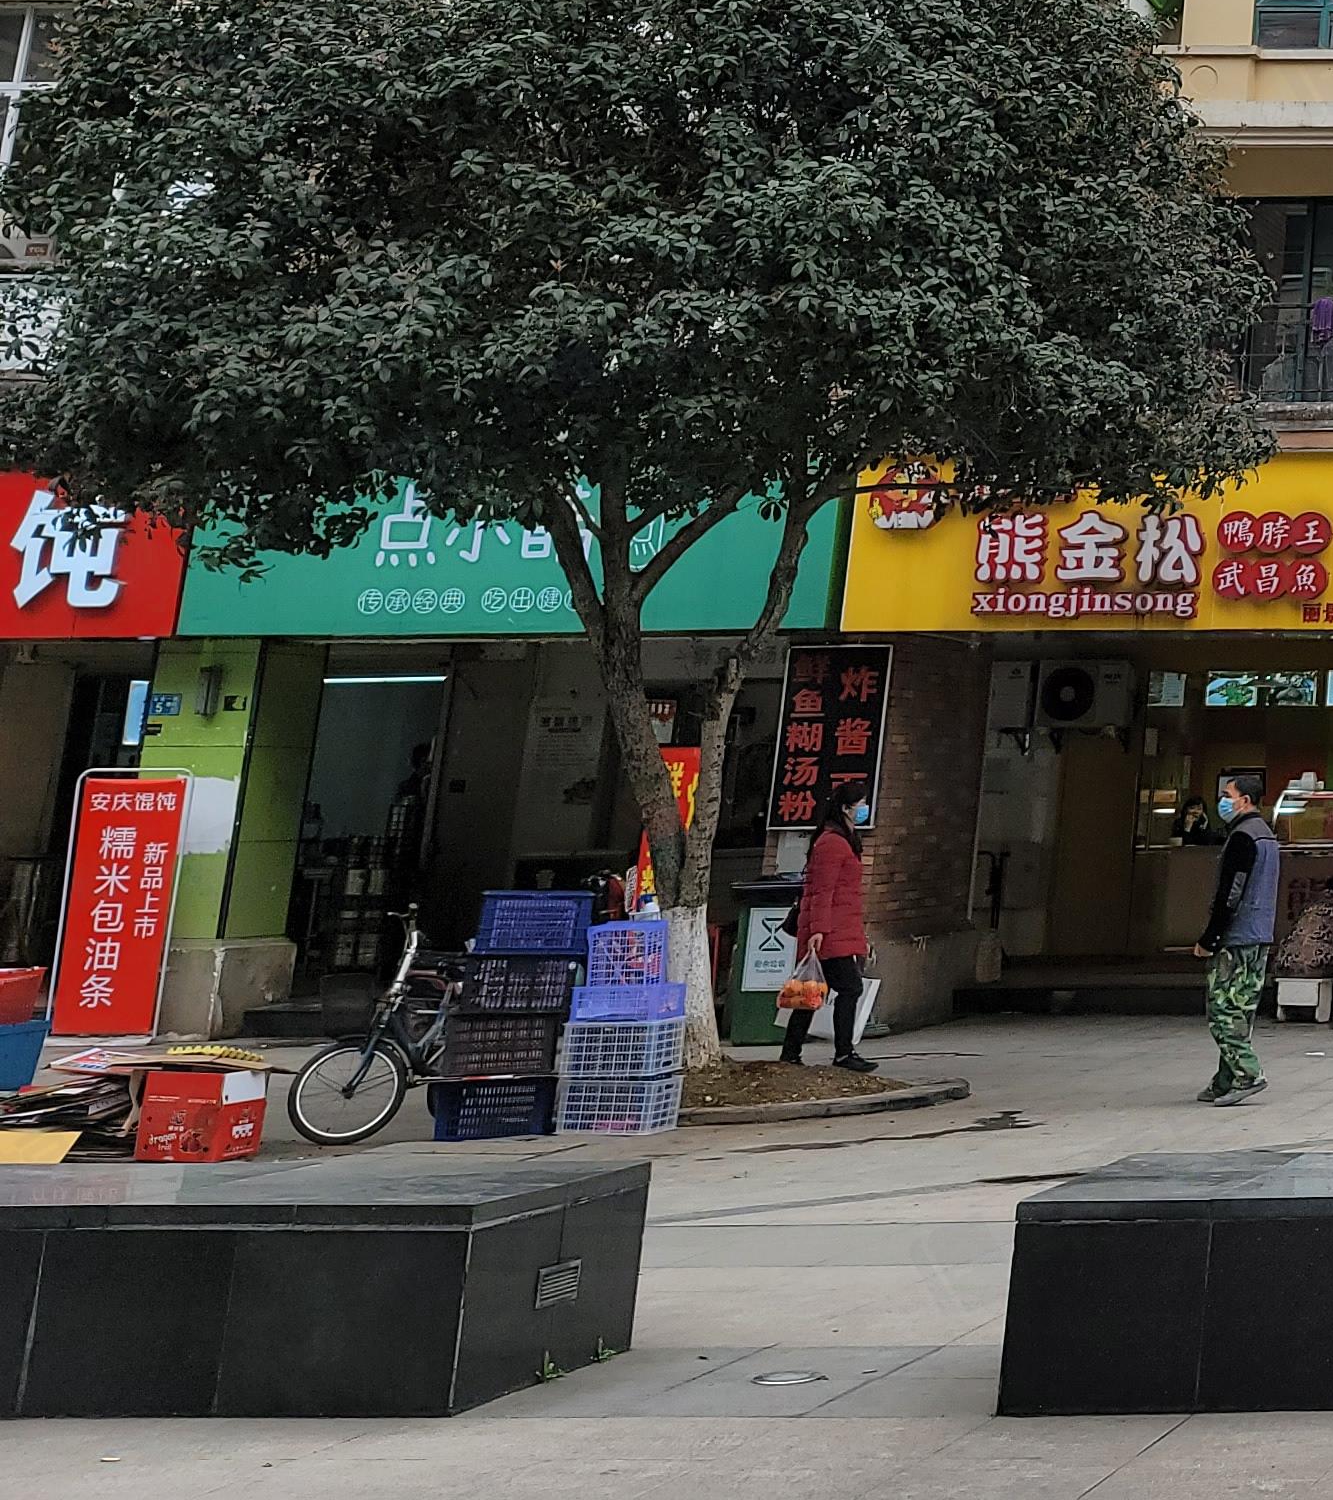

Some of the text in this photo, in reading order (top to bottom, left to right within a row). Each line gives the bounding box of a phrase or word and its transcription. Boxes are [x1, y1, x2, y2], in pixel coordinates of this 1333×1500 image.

[10, 489, 127, 610] 饨
[976, 511, 1203, 583] 熊金松
[1217, 562, 1317, 595] 武昌魚
[359, 589, 464, 613] 传承经典
[973, 588, 1196, 618] xiongjinsong
[778, 654, 831, 822] 鲜鱼糊汤粉
[89, 791, 178, 813] 安庆馄饨
[78, 825, 138, 1009] 糯米包油条
[132, 841, 169, 940] 新品上市
